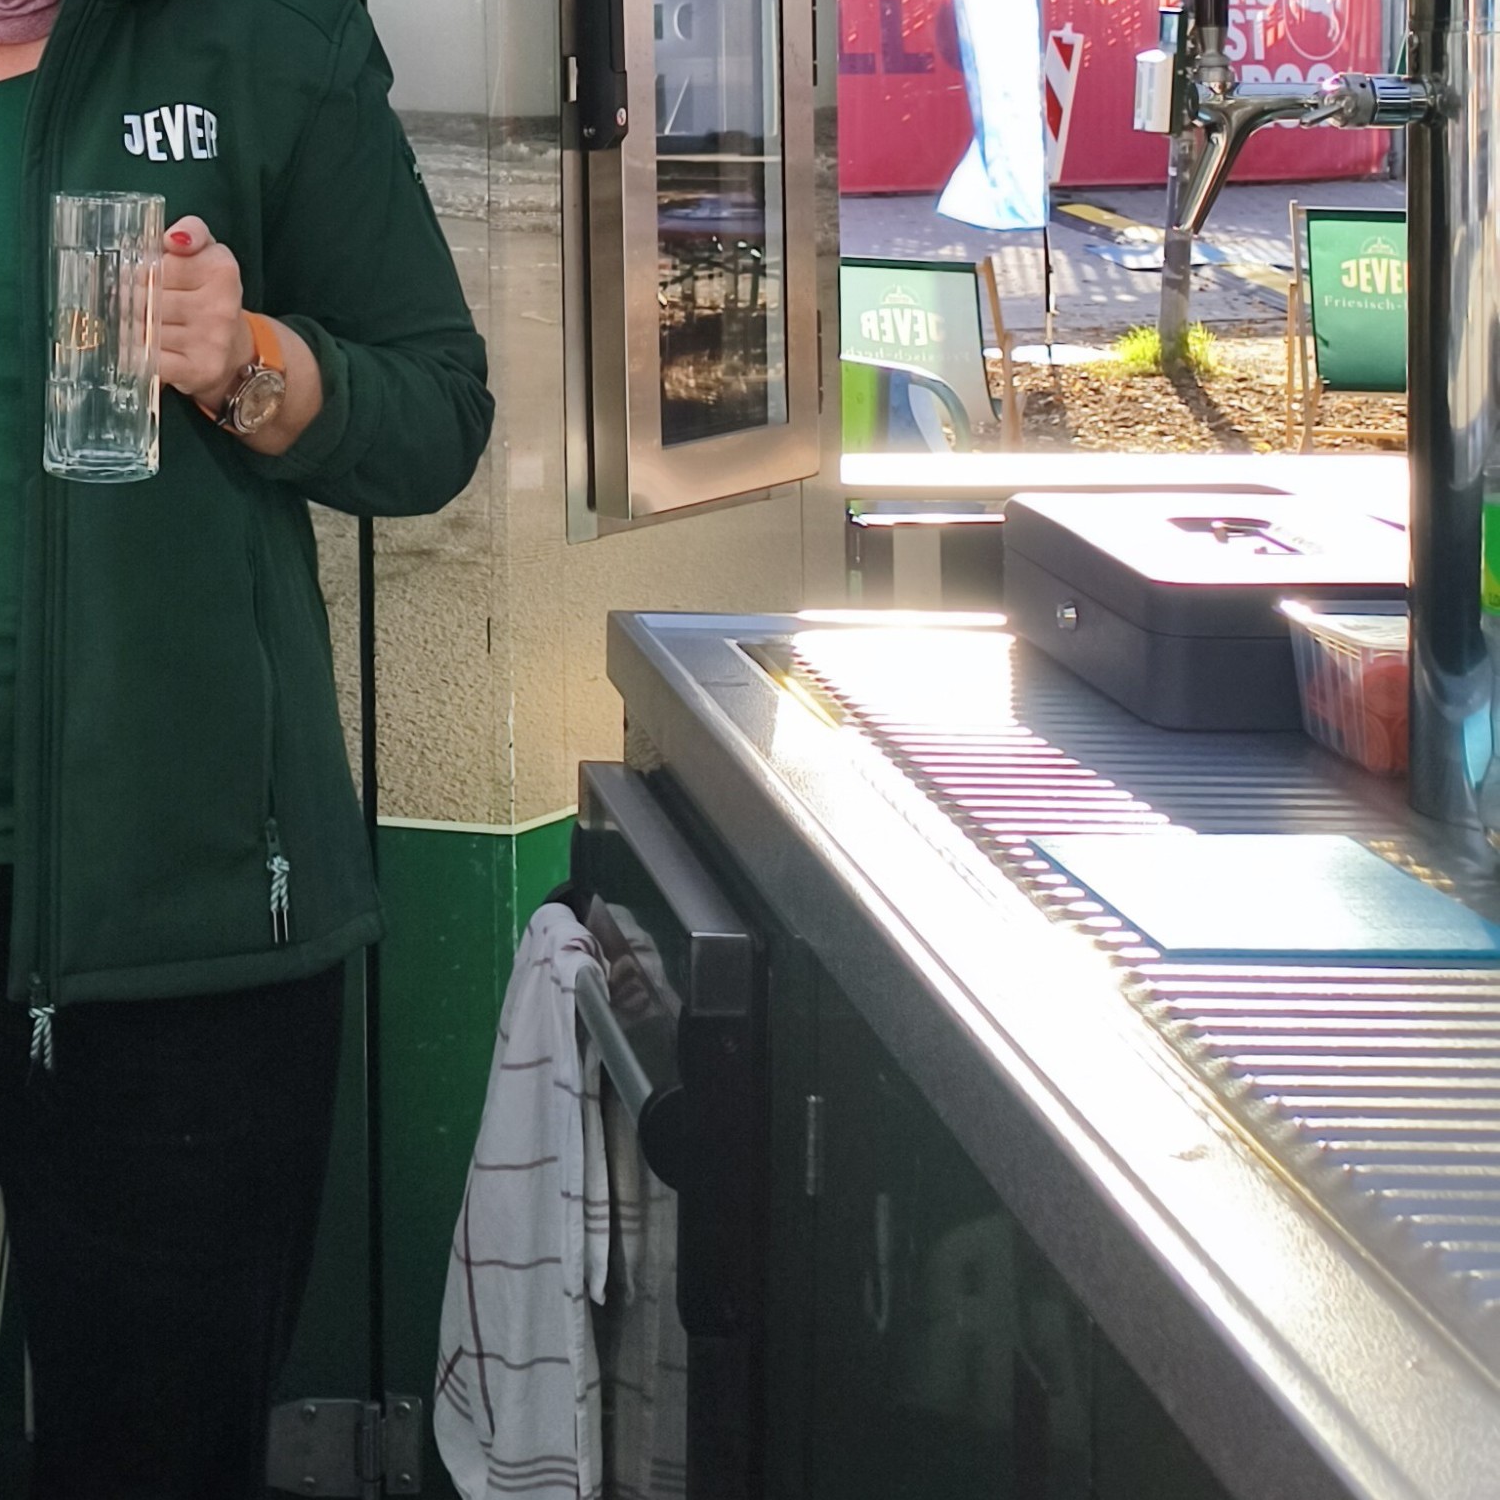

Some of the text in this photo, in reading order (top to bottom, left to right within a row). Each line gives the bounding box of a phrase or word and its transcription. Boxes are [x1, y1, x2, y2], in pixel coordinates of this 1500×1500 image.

[1224, 8, 1271, 62] ST
[123, 103, 218, 161] JEVER
[1340, 257, 1409, 295] JEVE
[1324, 294, 1409, 312] Friesisch-
